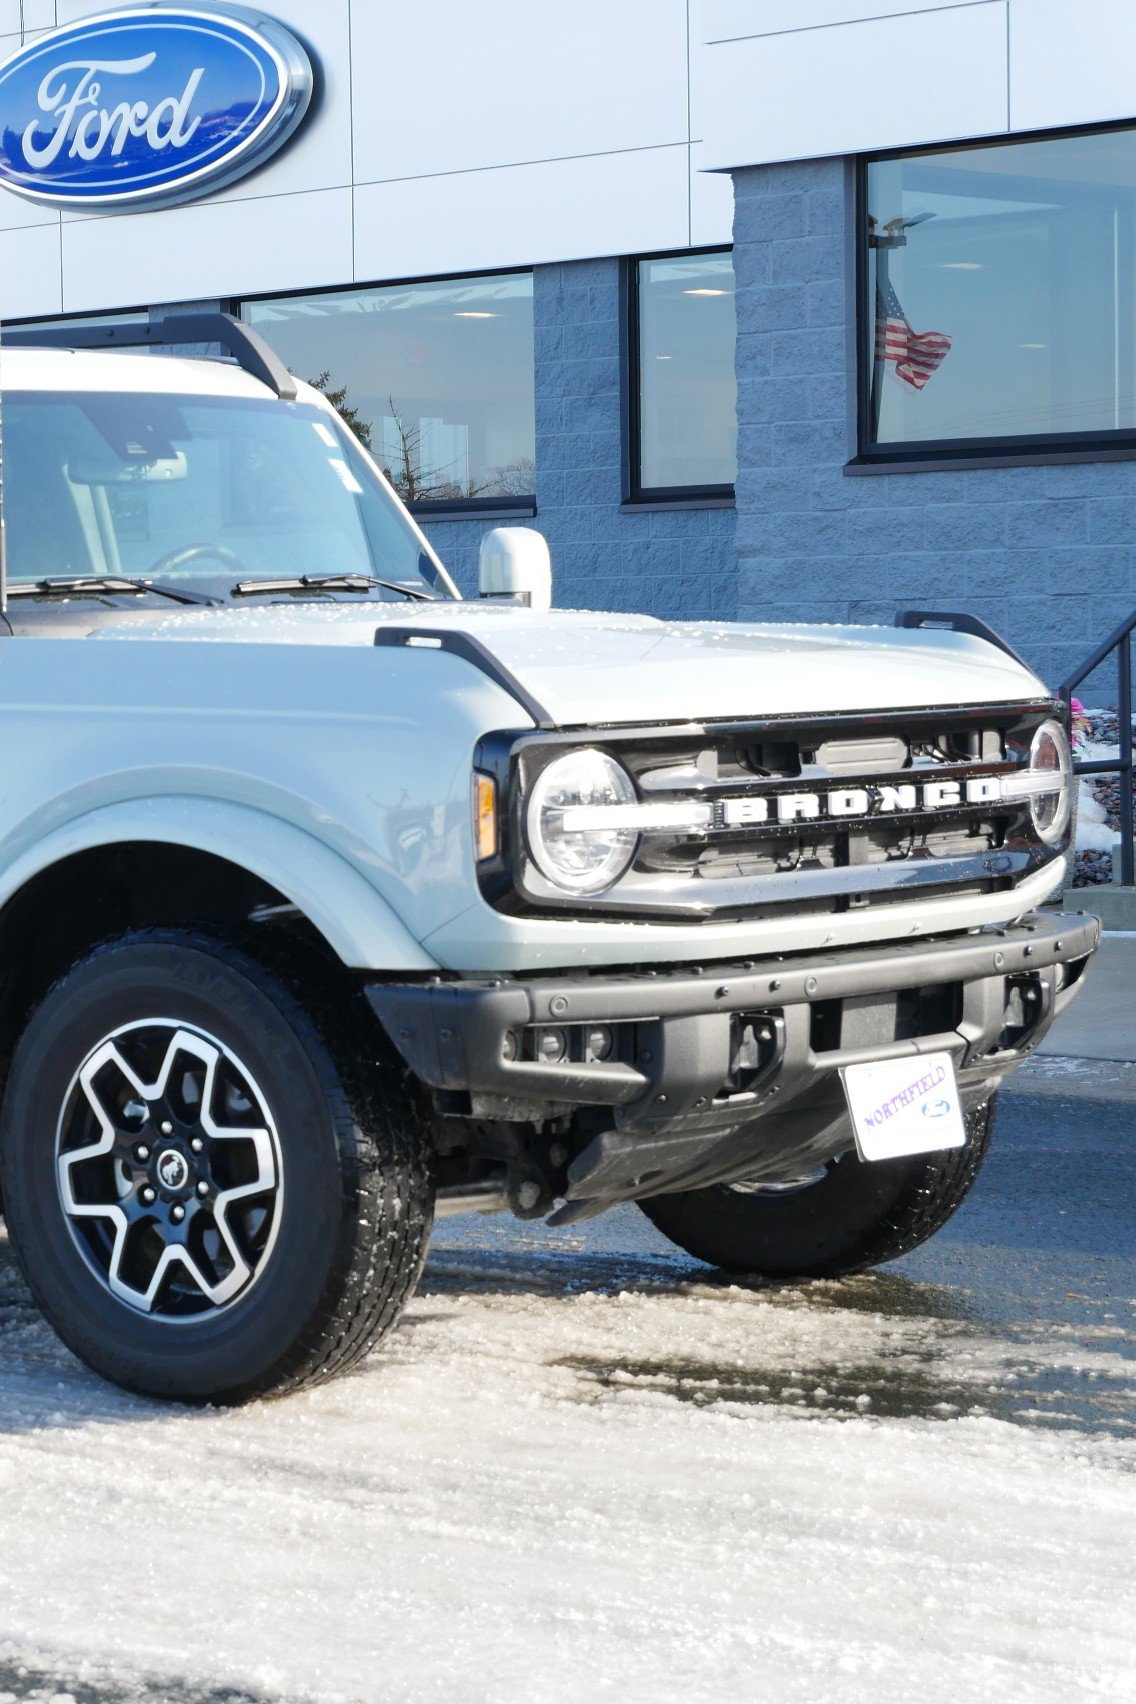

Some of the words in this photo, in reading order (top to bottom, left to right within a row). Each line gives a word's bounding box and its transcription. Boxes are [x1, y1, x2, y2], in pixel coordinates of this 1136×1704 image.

[21, 51, 205, 169] Ford
[724, 777, 1001, 824] BRONCO
[864, 1065, 946, 1128] NORTHFIELD
